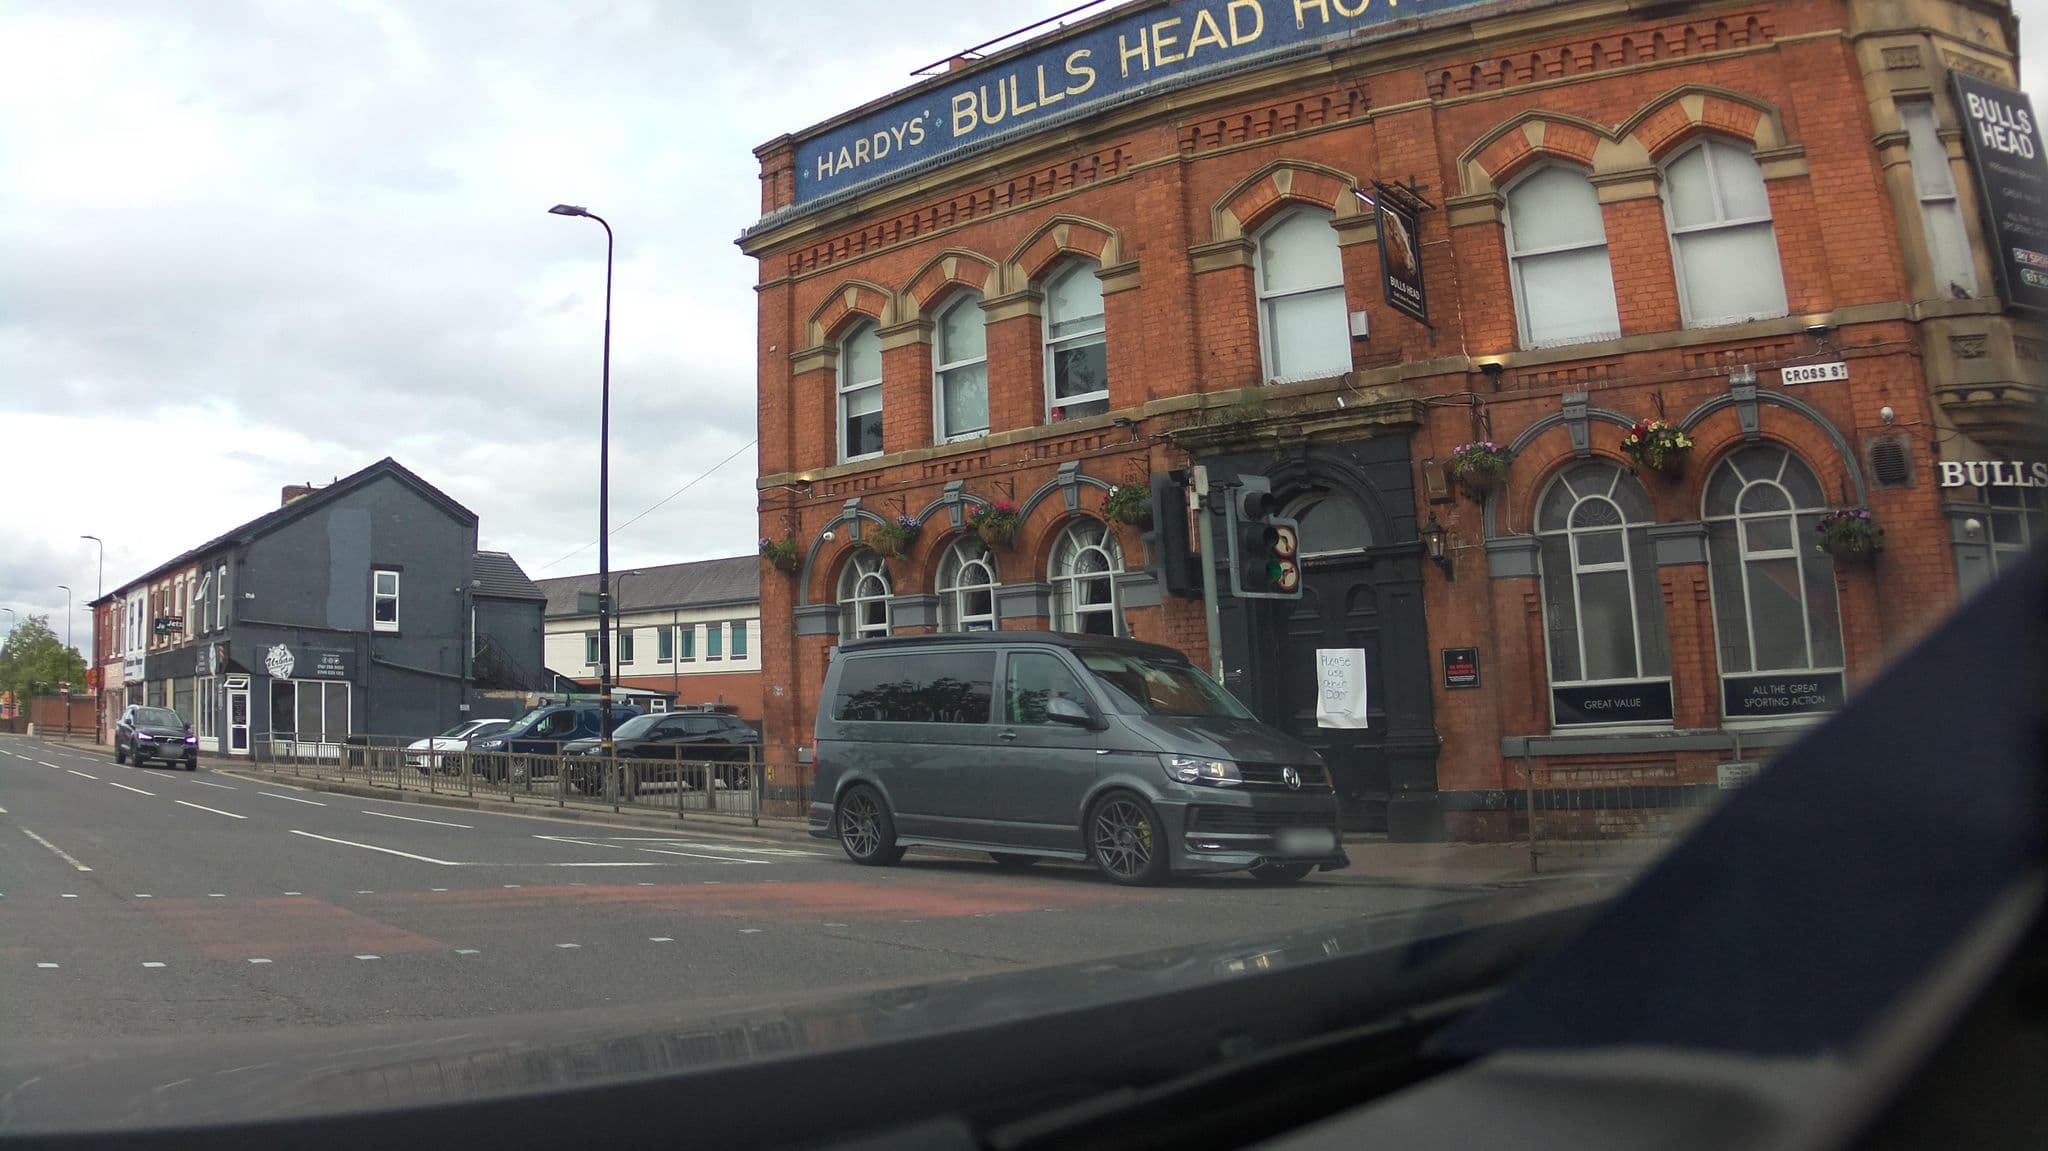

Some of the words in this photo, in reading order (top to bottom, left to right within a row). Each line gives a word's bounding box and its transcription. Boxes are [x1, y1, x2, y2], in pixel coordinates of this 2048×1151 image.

[951, 48, 1096, 138] BULLS
[1118, 0, 1265, 77] HEAD
[1966, 91, 2033, 134] BULLS
[1980, 120, 2034, 159] HEAD
[1389, 275, 1406, 293] BULLS
[1406, 285, 1420, 300] HEAD
[1785, 367, 1826, 382] CROSS
[1939, 461, 2048, 488] BULLS
[1743, 697, 1790, 708] SPORTING
[1791, 695, 1825, 706] ACTION
[1752, 685, 1769, 695] ALL
[1770, 684, 1786, 694] THE
[1789, 683, 1818, 694] GREAT
[1583, 699, 1613, 710] GREAT
[1614, 697, 1641, 708] VALUE
